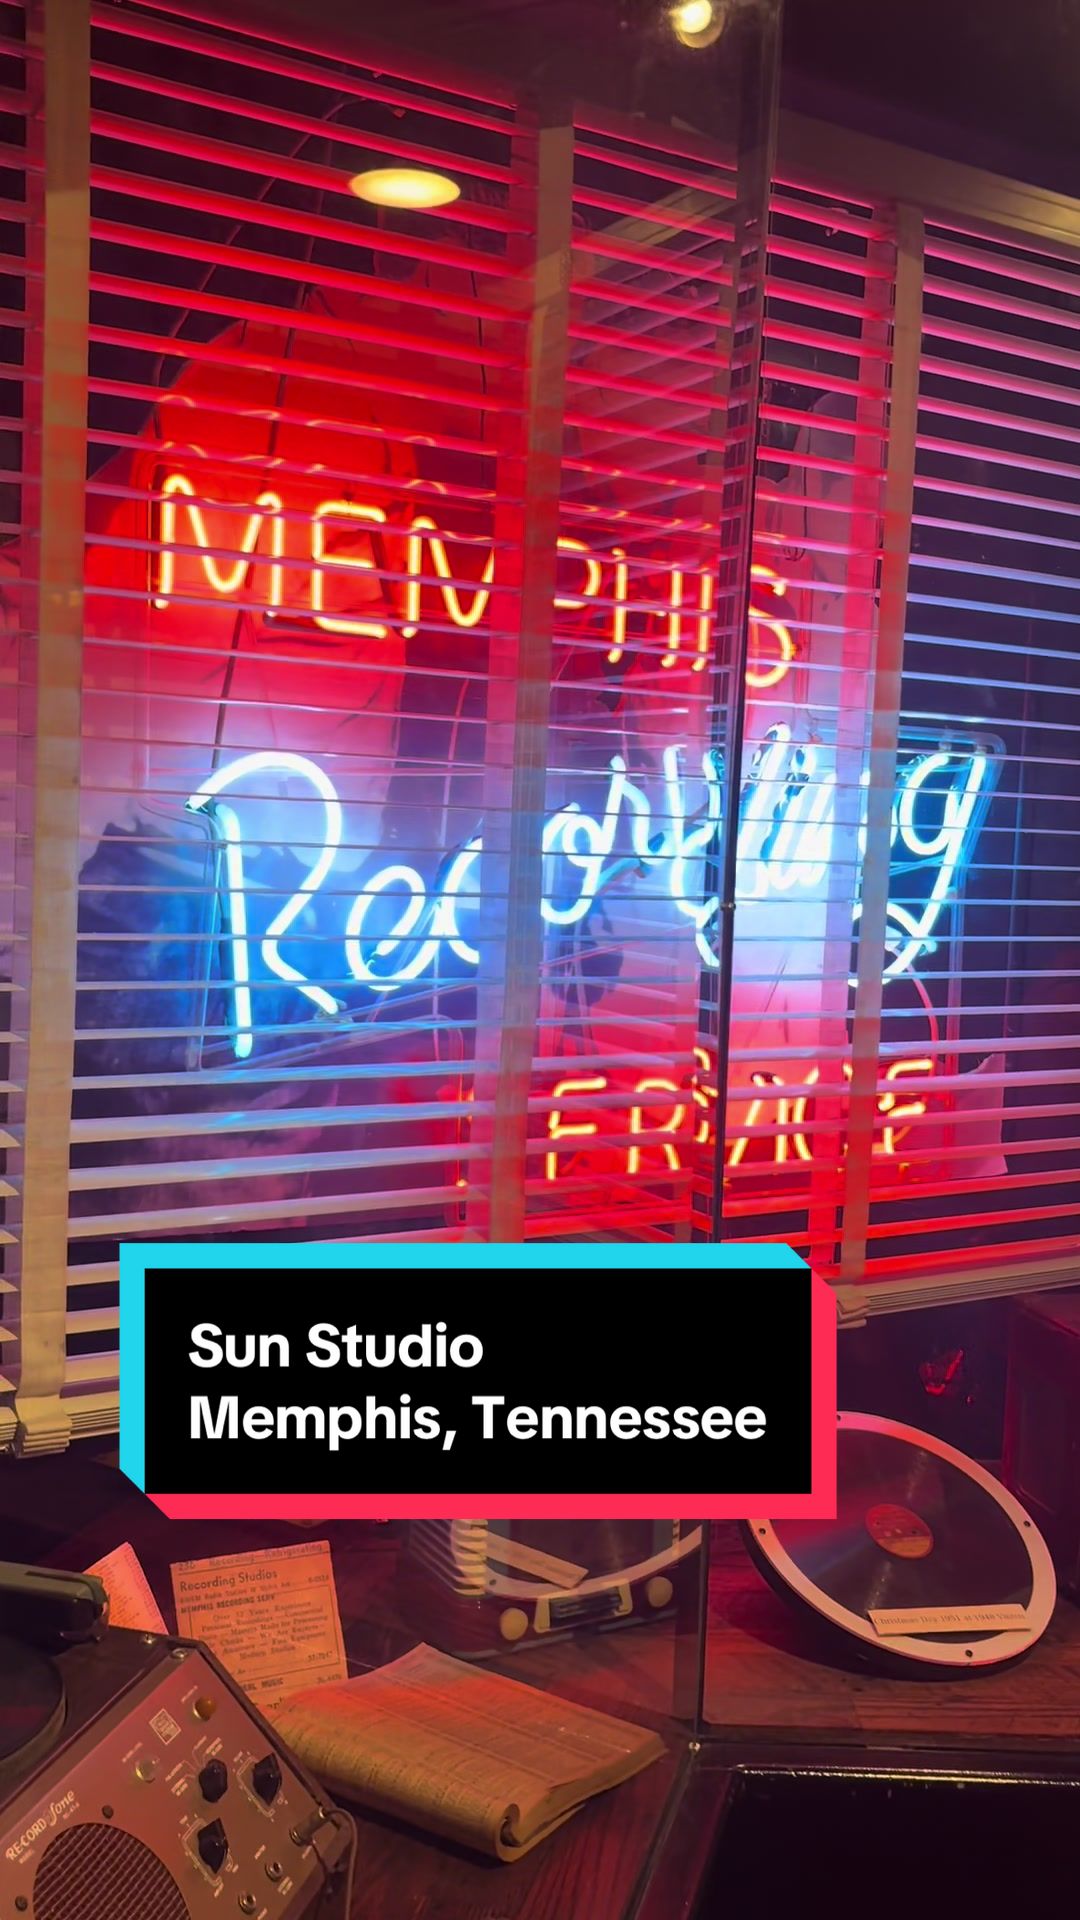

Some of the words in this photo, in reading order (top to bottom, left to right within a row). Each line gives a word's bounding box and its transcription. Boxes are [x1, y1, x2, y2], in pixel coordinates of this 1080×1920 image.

[153, 474, 794, 688] MEMPHIS
[180, 1576, 236, 1592] Recording
[238, 1569, 278, 1583] Studios
